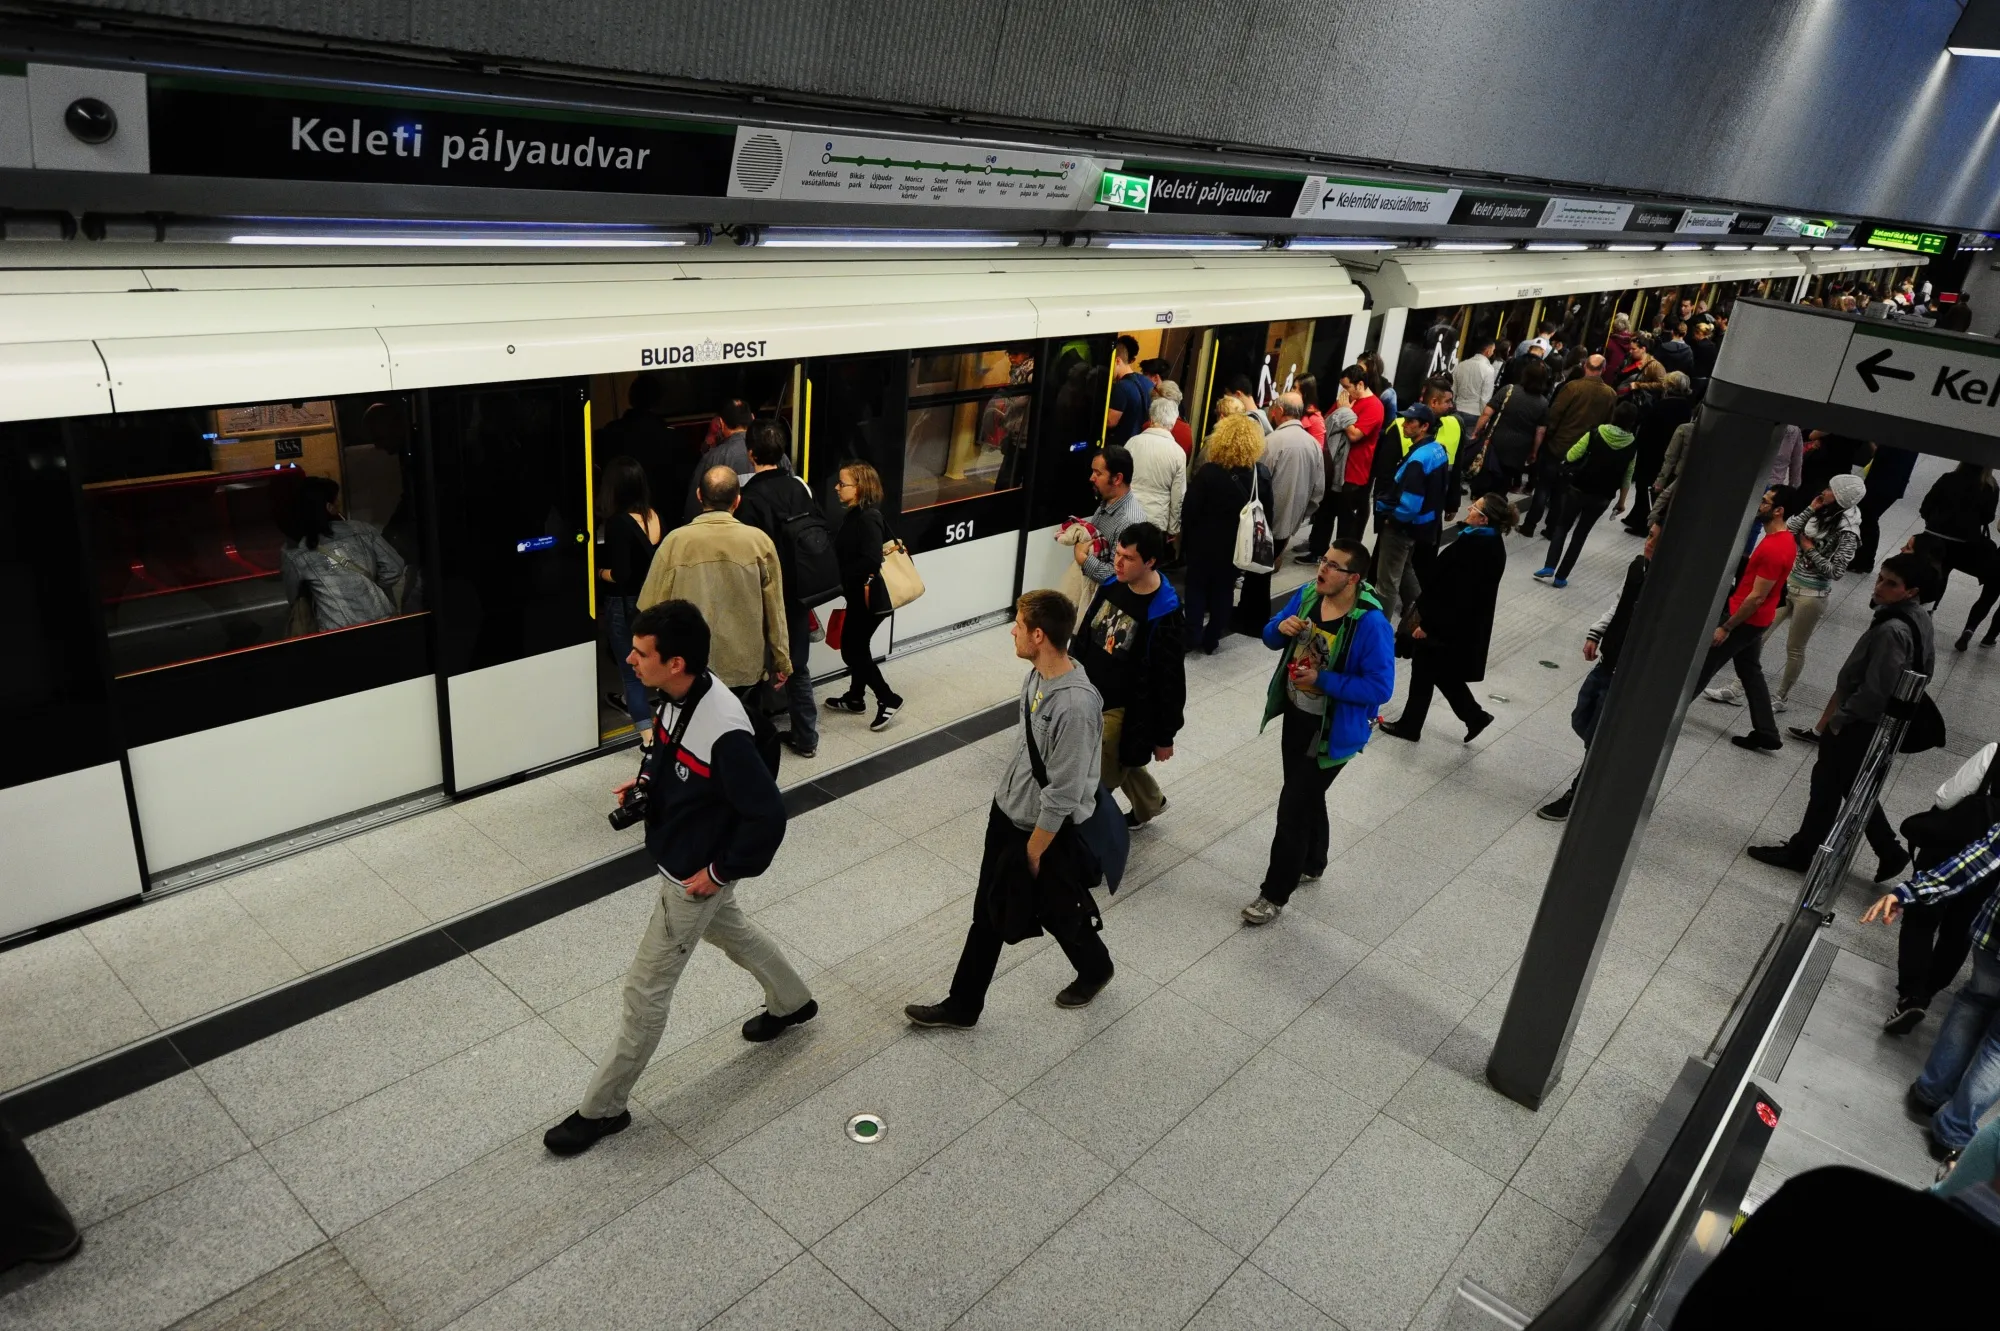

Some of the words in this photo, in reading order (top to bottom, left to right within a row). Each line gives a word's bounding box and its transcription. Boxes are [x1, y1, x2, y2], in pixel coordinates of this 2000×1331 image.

[291, 116, 423, 157] Keleti
[441, 128, 650, 172] pályaudvar
[808, 169, 838, 178] Kelenföld
[849, 172, 865, 180] Bikás
[801, 179, 841, 188] vasútállomás
[848, 181, 862, 189] park
[899, 183, 925, 192] Zsigmond
[1153, 179, 1198, 199] Keleti
[1197, 182, 1272, 206] pályaudvar
[1336, 192, 1381, 210] Kelenföld
[1380, 196, 1431, 212] vasútállomás
[1470, 202, 1495, 216] Keleti
[945, 520, 974, 543] 561
